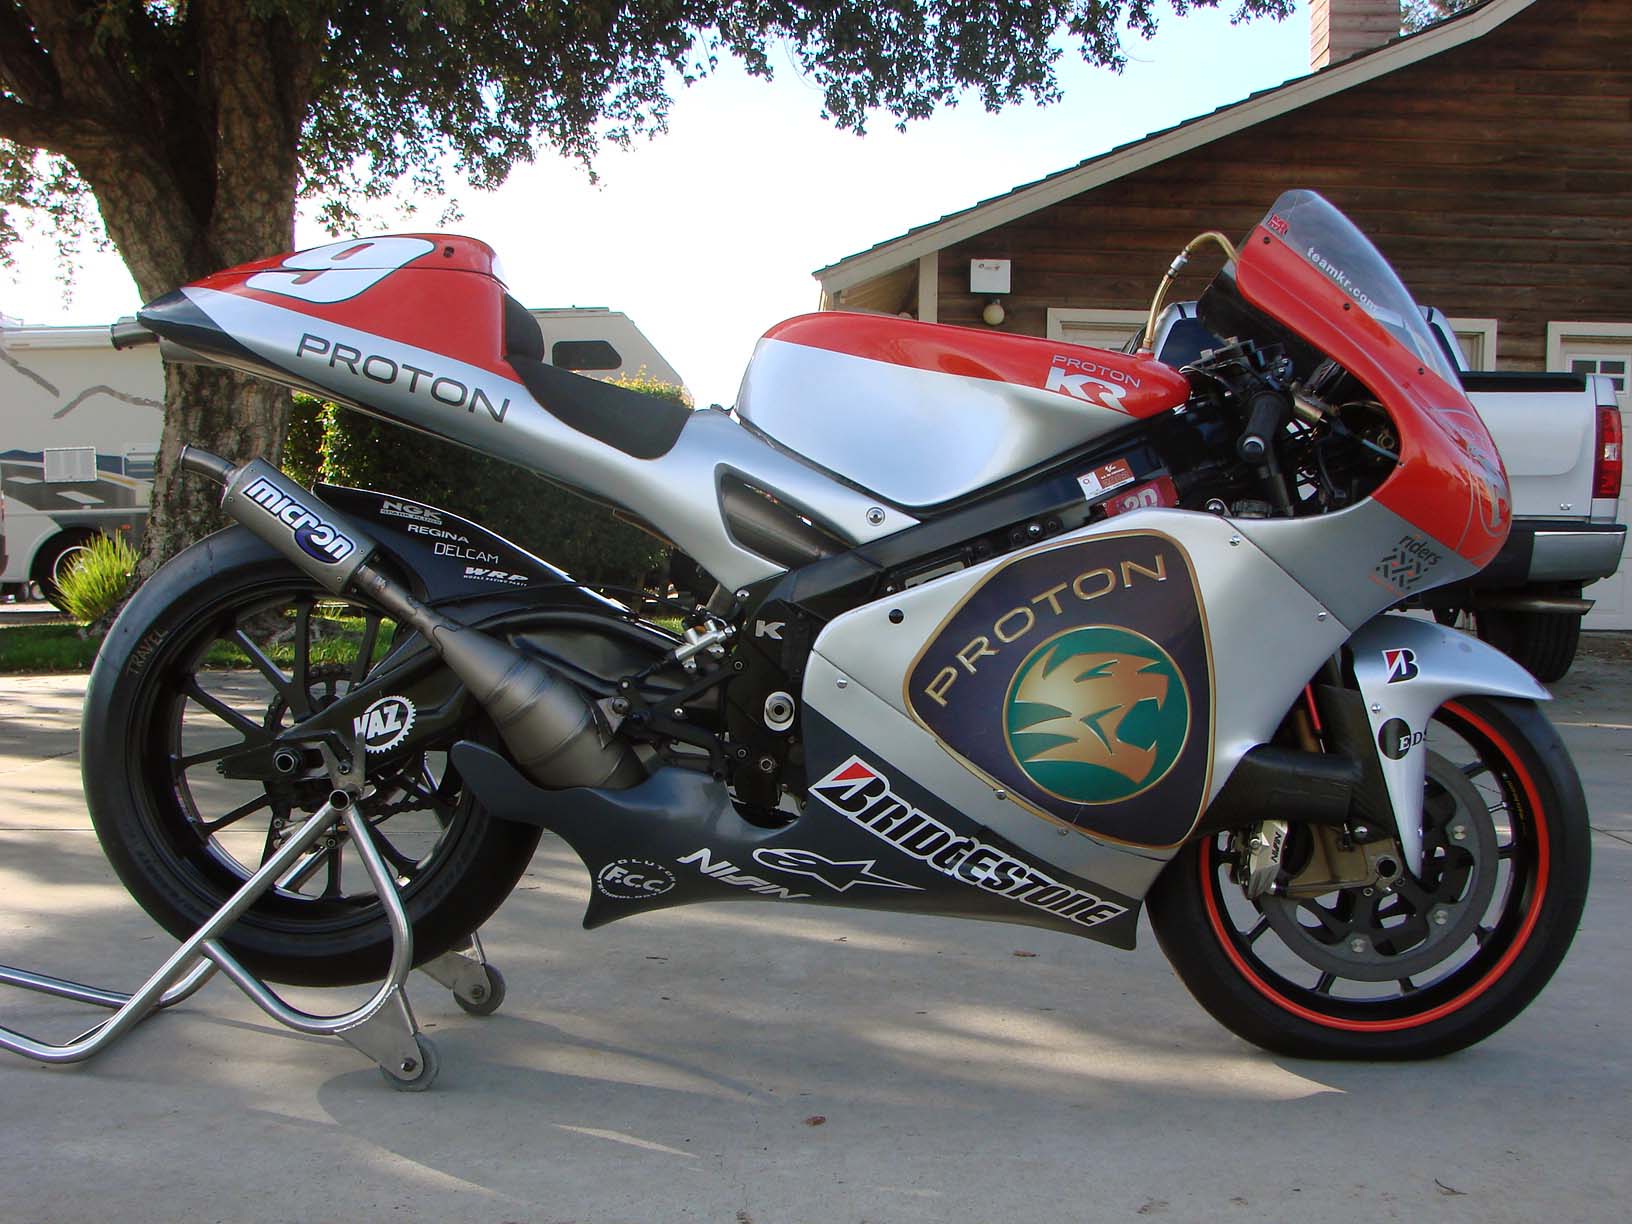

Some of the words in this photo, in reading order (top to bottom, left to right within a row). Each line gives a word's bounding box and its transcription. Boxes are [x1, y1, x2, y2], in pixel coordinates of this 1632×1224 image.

[1307, 247, 1378, 313] teamkr.com
[296, 332, 511, 424] PROTON
[1045, 366, 1130, 415] KR
[1052, 354, 1141, 389] PROTON
[243, 477, 356, 562] micron
[382, 500, 442, 520] NGK
[407, 523, 470, 544] REGINA
[433, 541, 499, 564] DELCAM
[464, 566, 529, 581] WRP
[1398, 534, 1442, 566] riders
[127, 628, 169, 675] TRAVEL
[924, 553, 1168, 708] PROTON
[808, 754, 1129, 928] BRIDGESTONE
